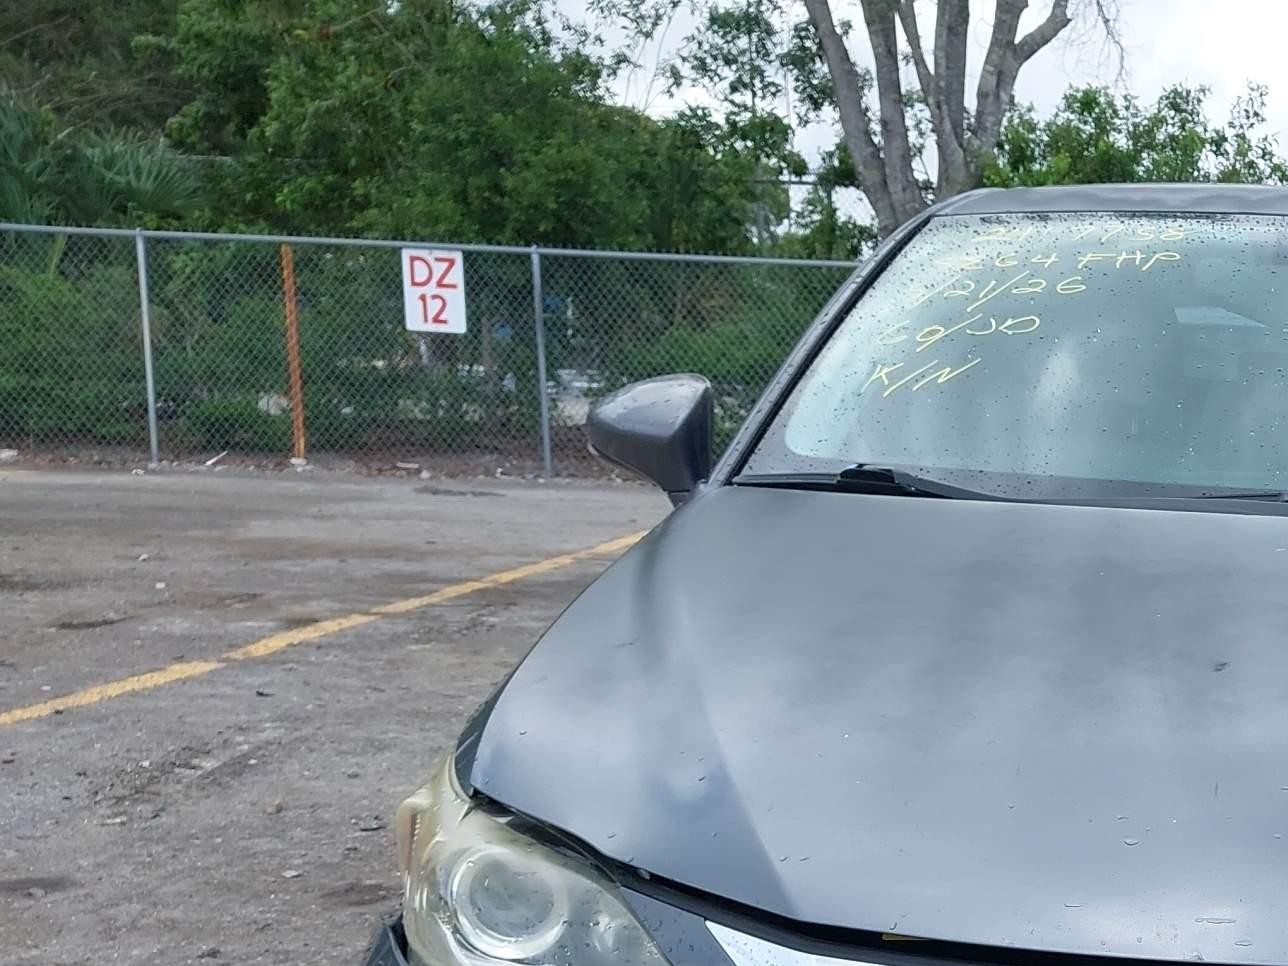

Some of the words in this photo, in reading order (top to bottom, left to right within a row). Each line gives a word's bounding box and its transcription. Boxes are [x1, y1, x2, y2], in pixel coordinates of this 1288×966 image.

[408, 255, 458, 289] DZ
[1077, 250, 1182, 272] FHP
[418, 293, 449, 324] 12
